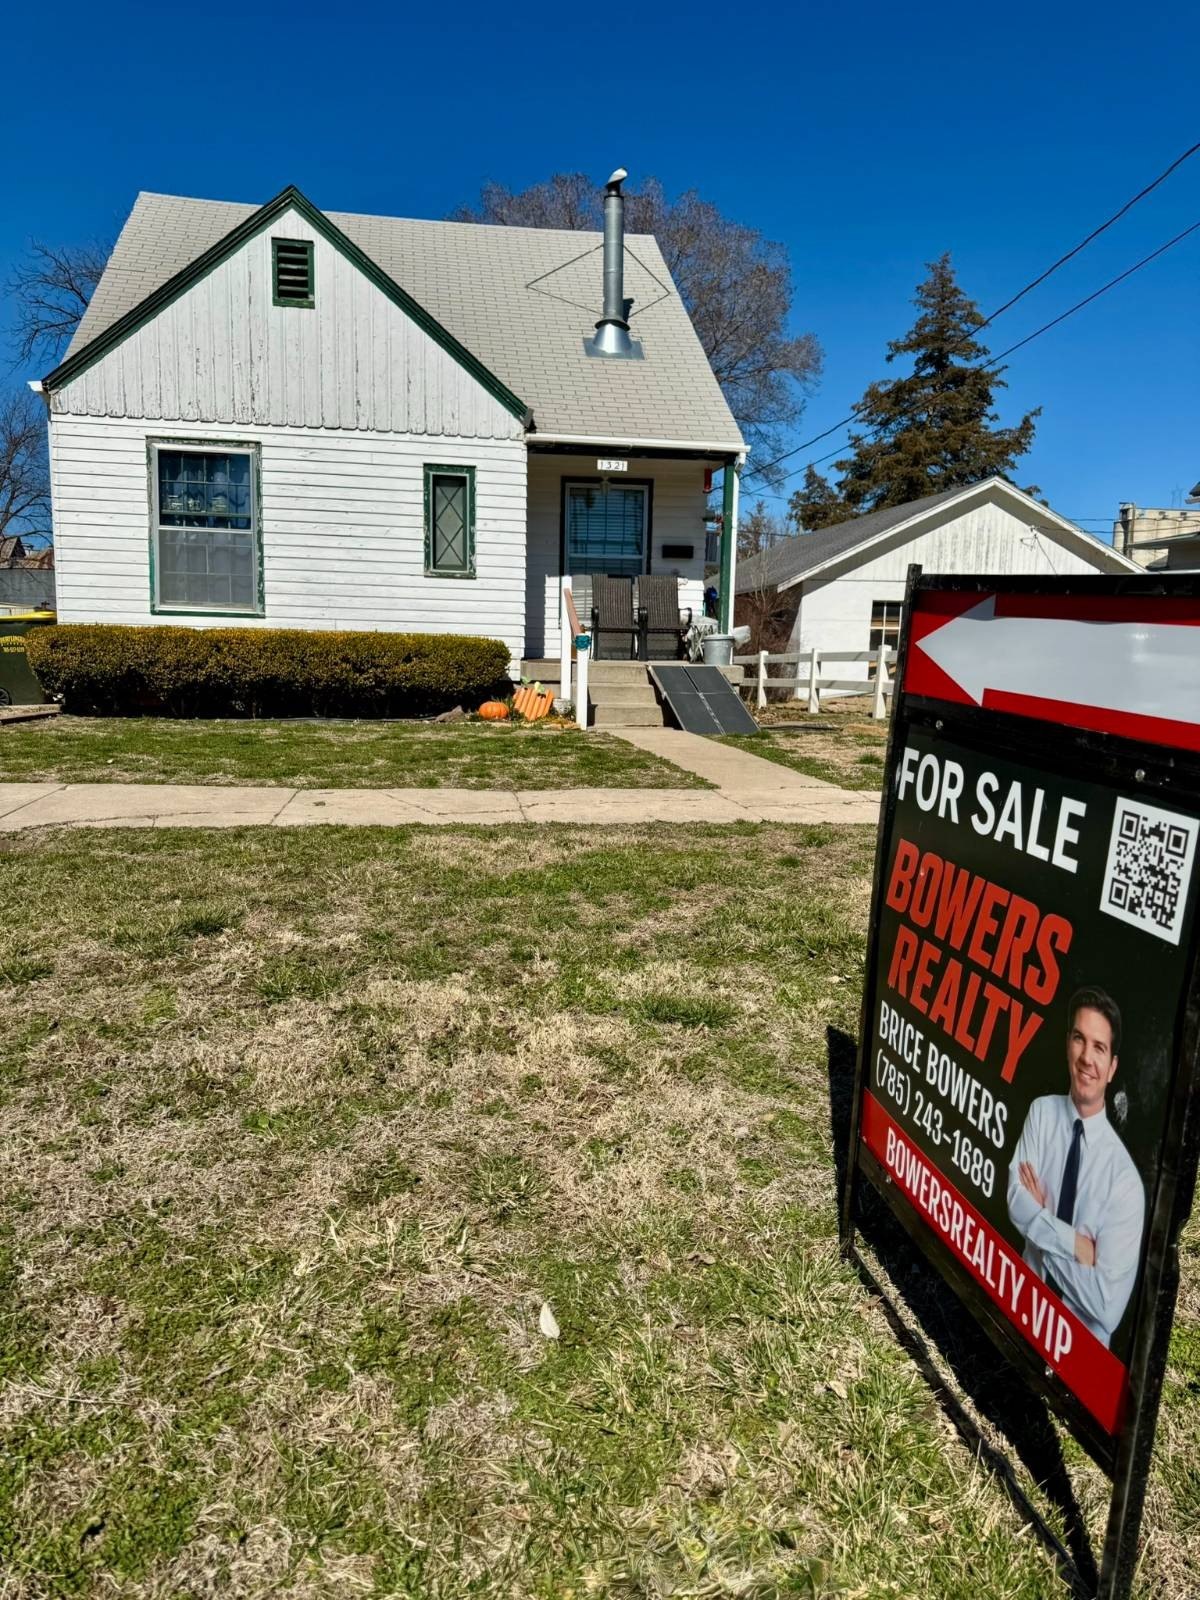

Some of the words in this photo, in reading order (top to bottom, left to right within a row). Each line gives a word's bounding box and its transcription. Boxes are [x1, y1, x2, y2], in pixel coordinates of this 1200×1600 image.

[601, 461, 625, 471] 1321
[898, 747, 964, 824] FOR
[971, 771, 1087, 873] SALE
[886, 838, 1073, 1006] BOWERS
[879, 1000, 922, 1074] BRICE
[927, 1042, 1008, 1149] BOWERS
[887, 924, 1044, 1084] REALTY
[876, 1048, 911, 1116] (785)
[913, 1087, 996, 1199] 243-1689
[885, 1126, 1073, 1363] BOWERSREALTY.VIP
